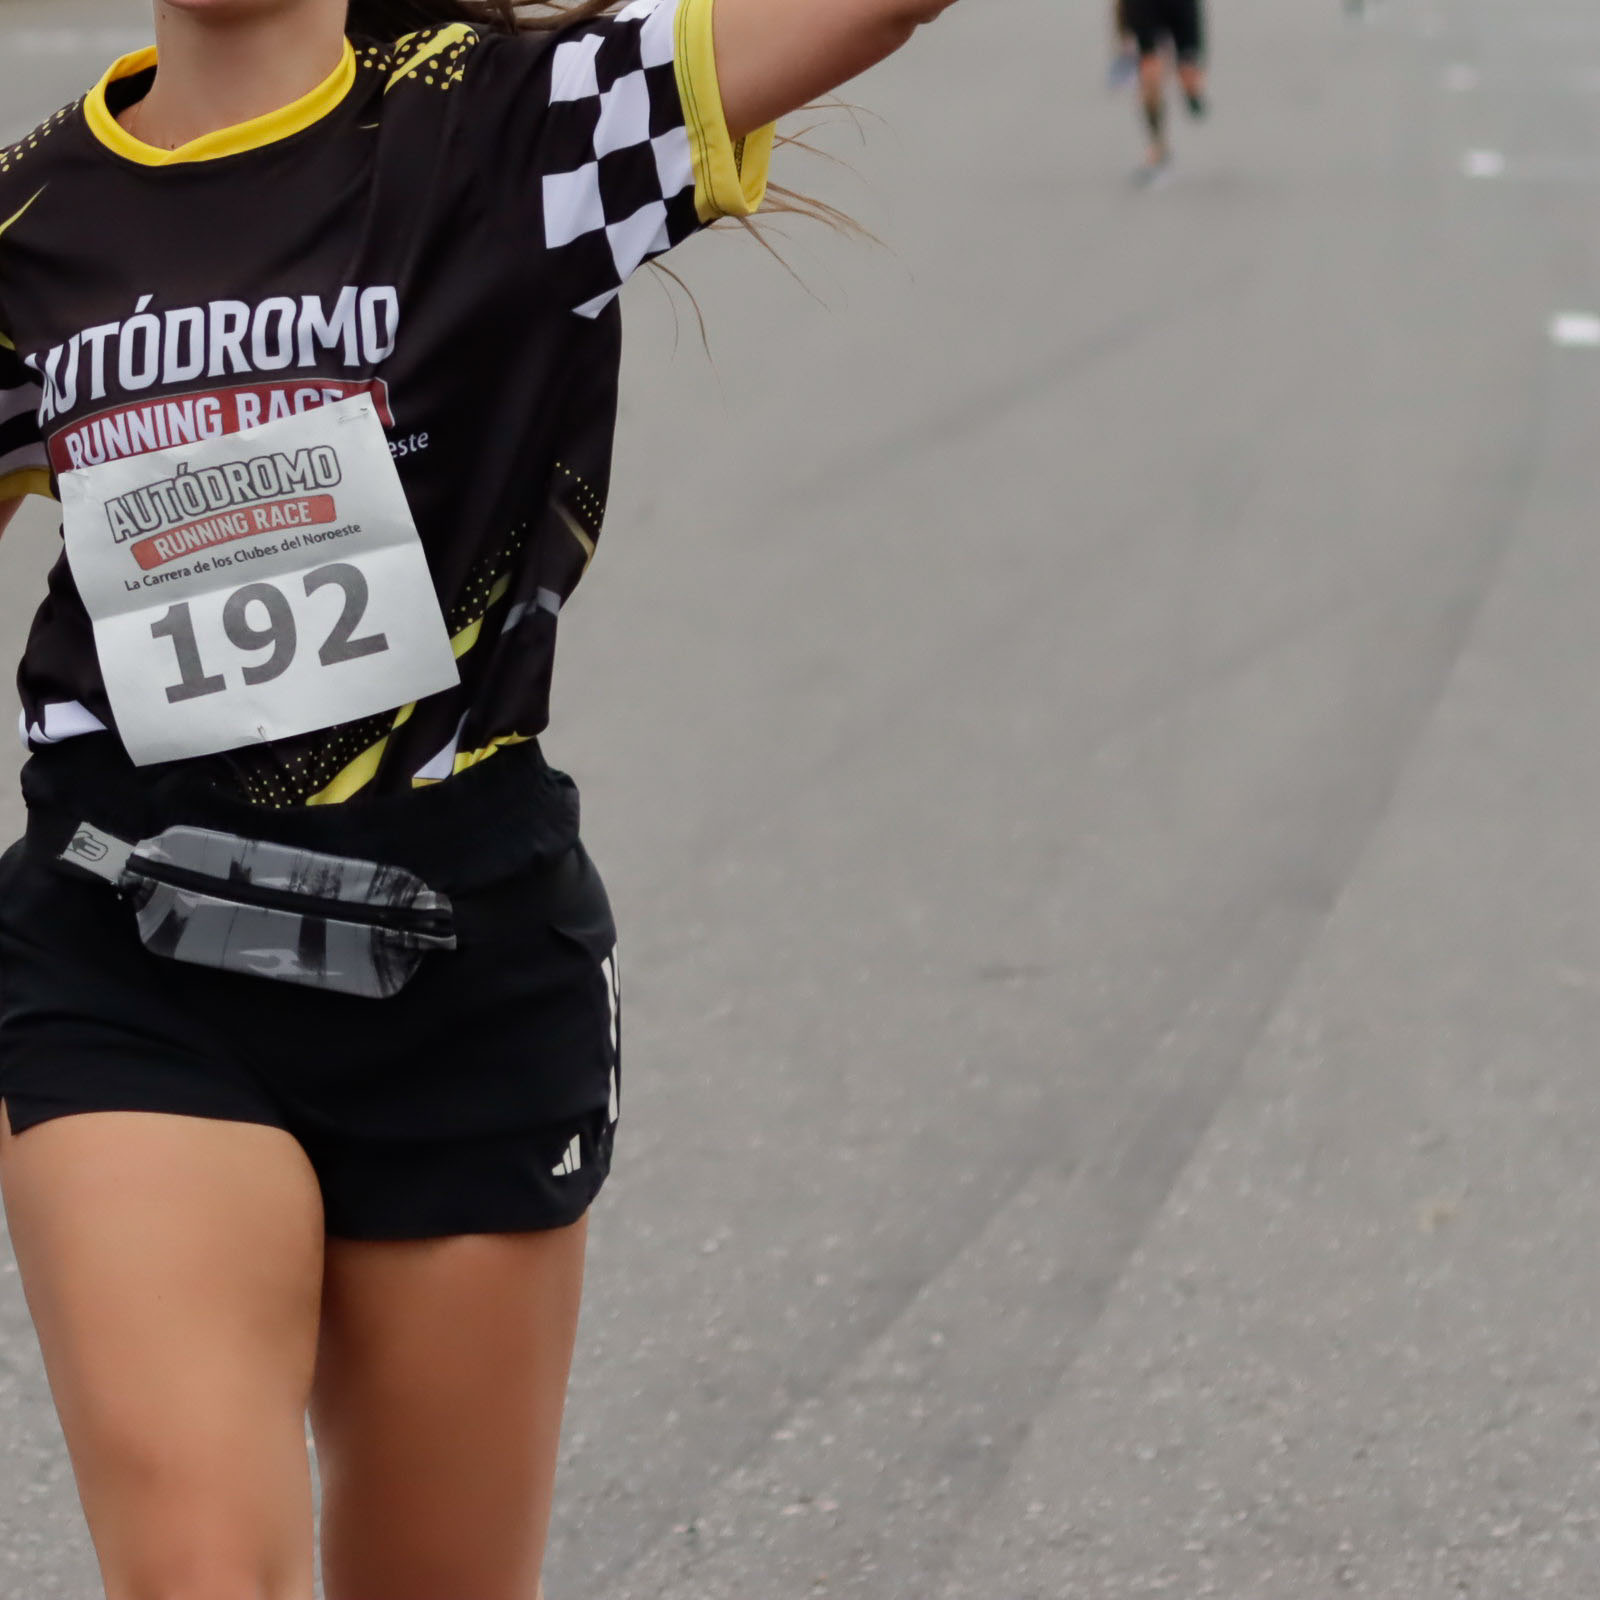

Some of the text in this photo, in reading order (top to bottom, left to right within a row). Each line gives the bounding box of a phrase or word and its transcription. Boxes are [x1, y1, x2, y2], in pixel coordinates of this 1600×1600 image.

[65, 396, 224, 470] RUNNING
[104, 445, 342, 543] AUTÓDROMO
[153, 501, 312, 561] RUNNING RACE
[124, 523, 362, 592] La Carrera de los Clubes del Noroeste
[150, 561, 390, 705] 192
